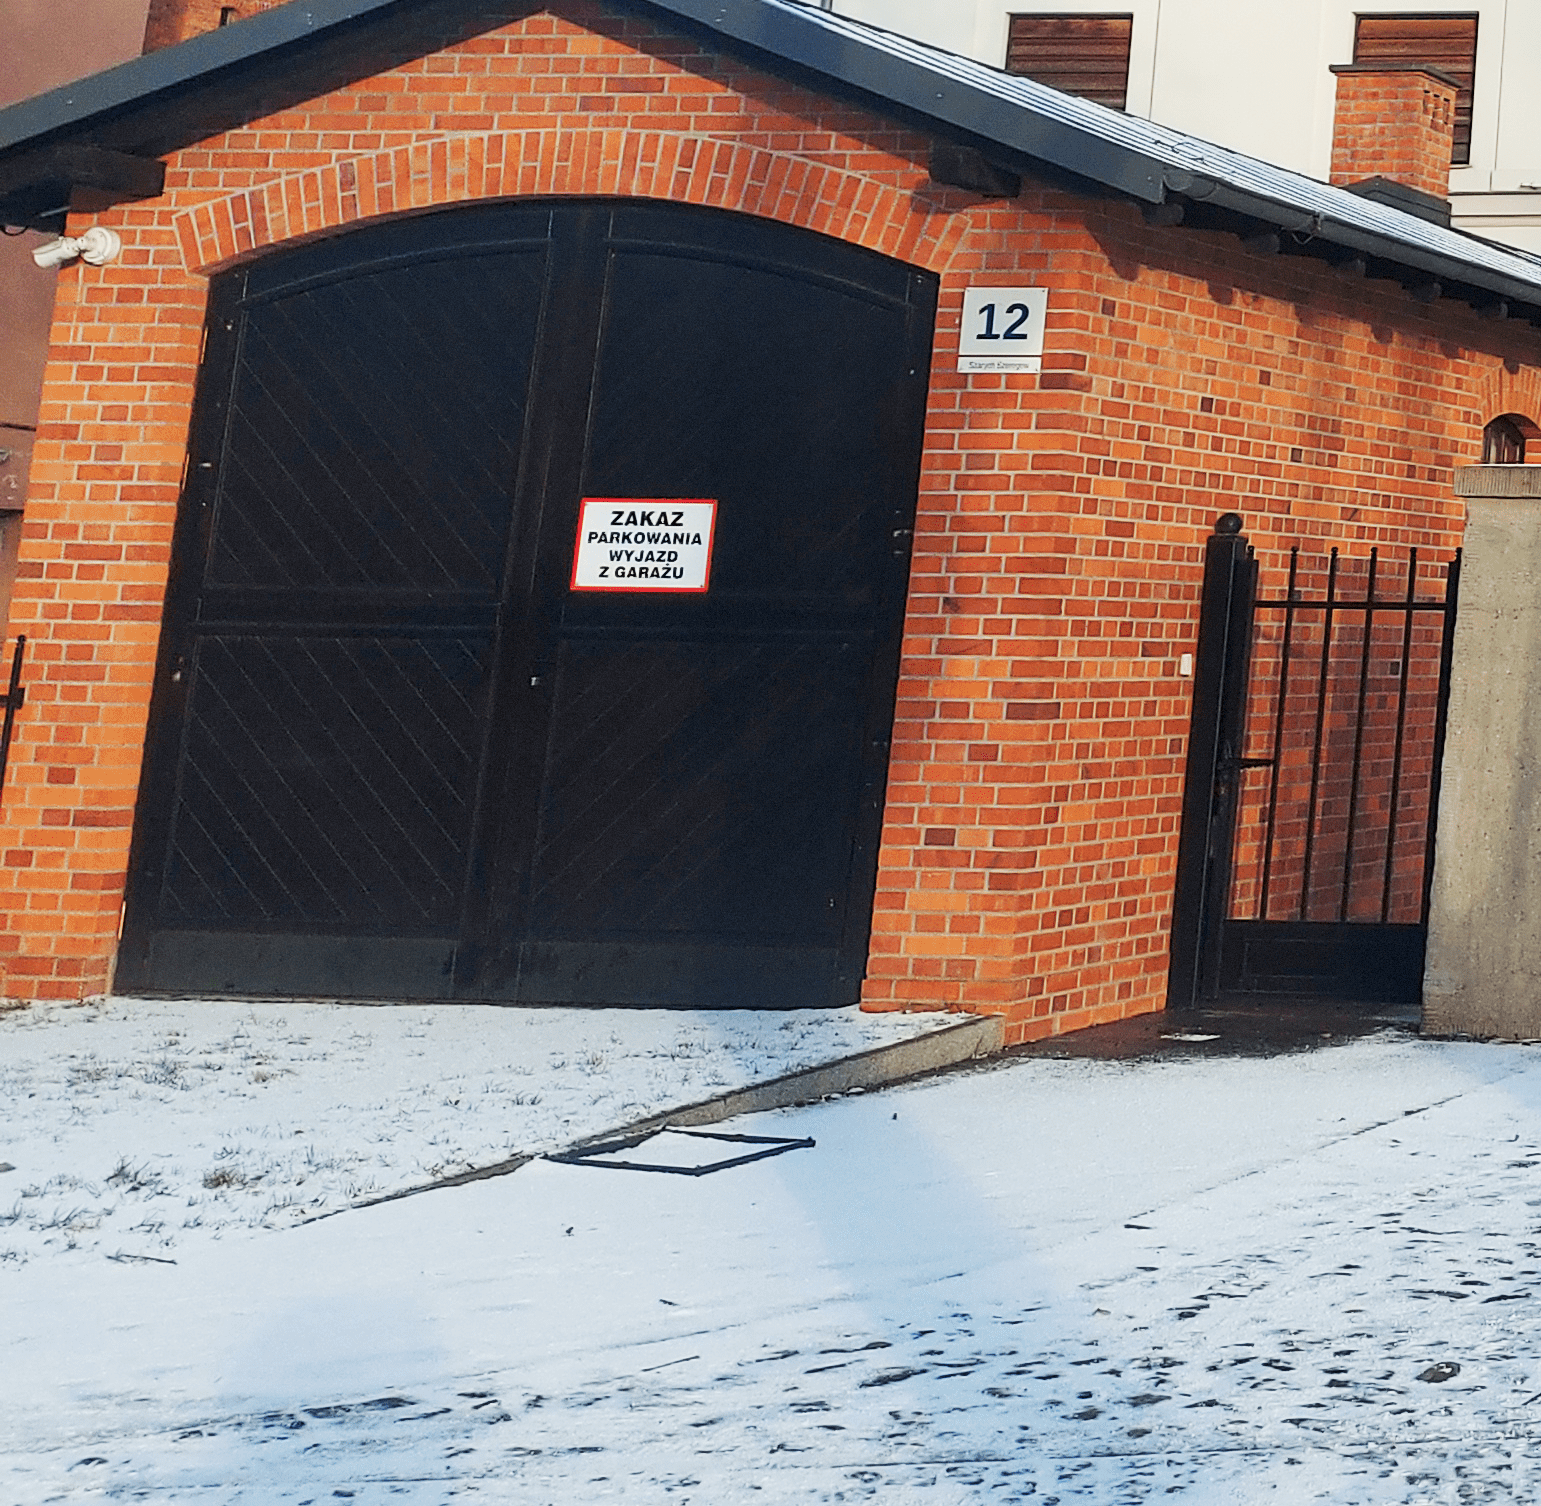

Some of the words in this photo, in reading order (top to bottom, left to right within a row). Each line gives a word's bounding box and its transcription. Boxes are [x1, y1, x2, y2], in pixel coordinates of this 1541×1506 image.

[976, 303, 1029, 339] 12
[611, 511, 684, 526] ZAKAZ
[588, 532, 702, 545] PARKOWANIA
[609, 550, 678, 563] WYJAZD
[599, 566, 609, 578] Z
[615, 563, 684, 579] GARAŻU
